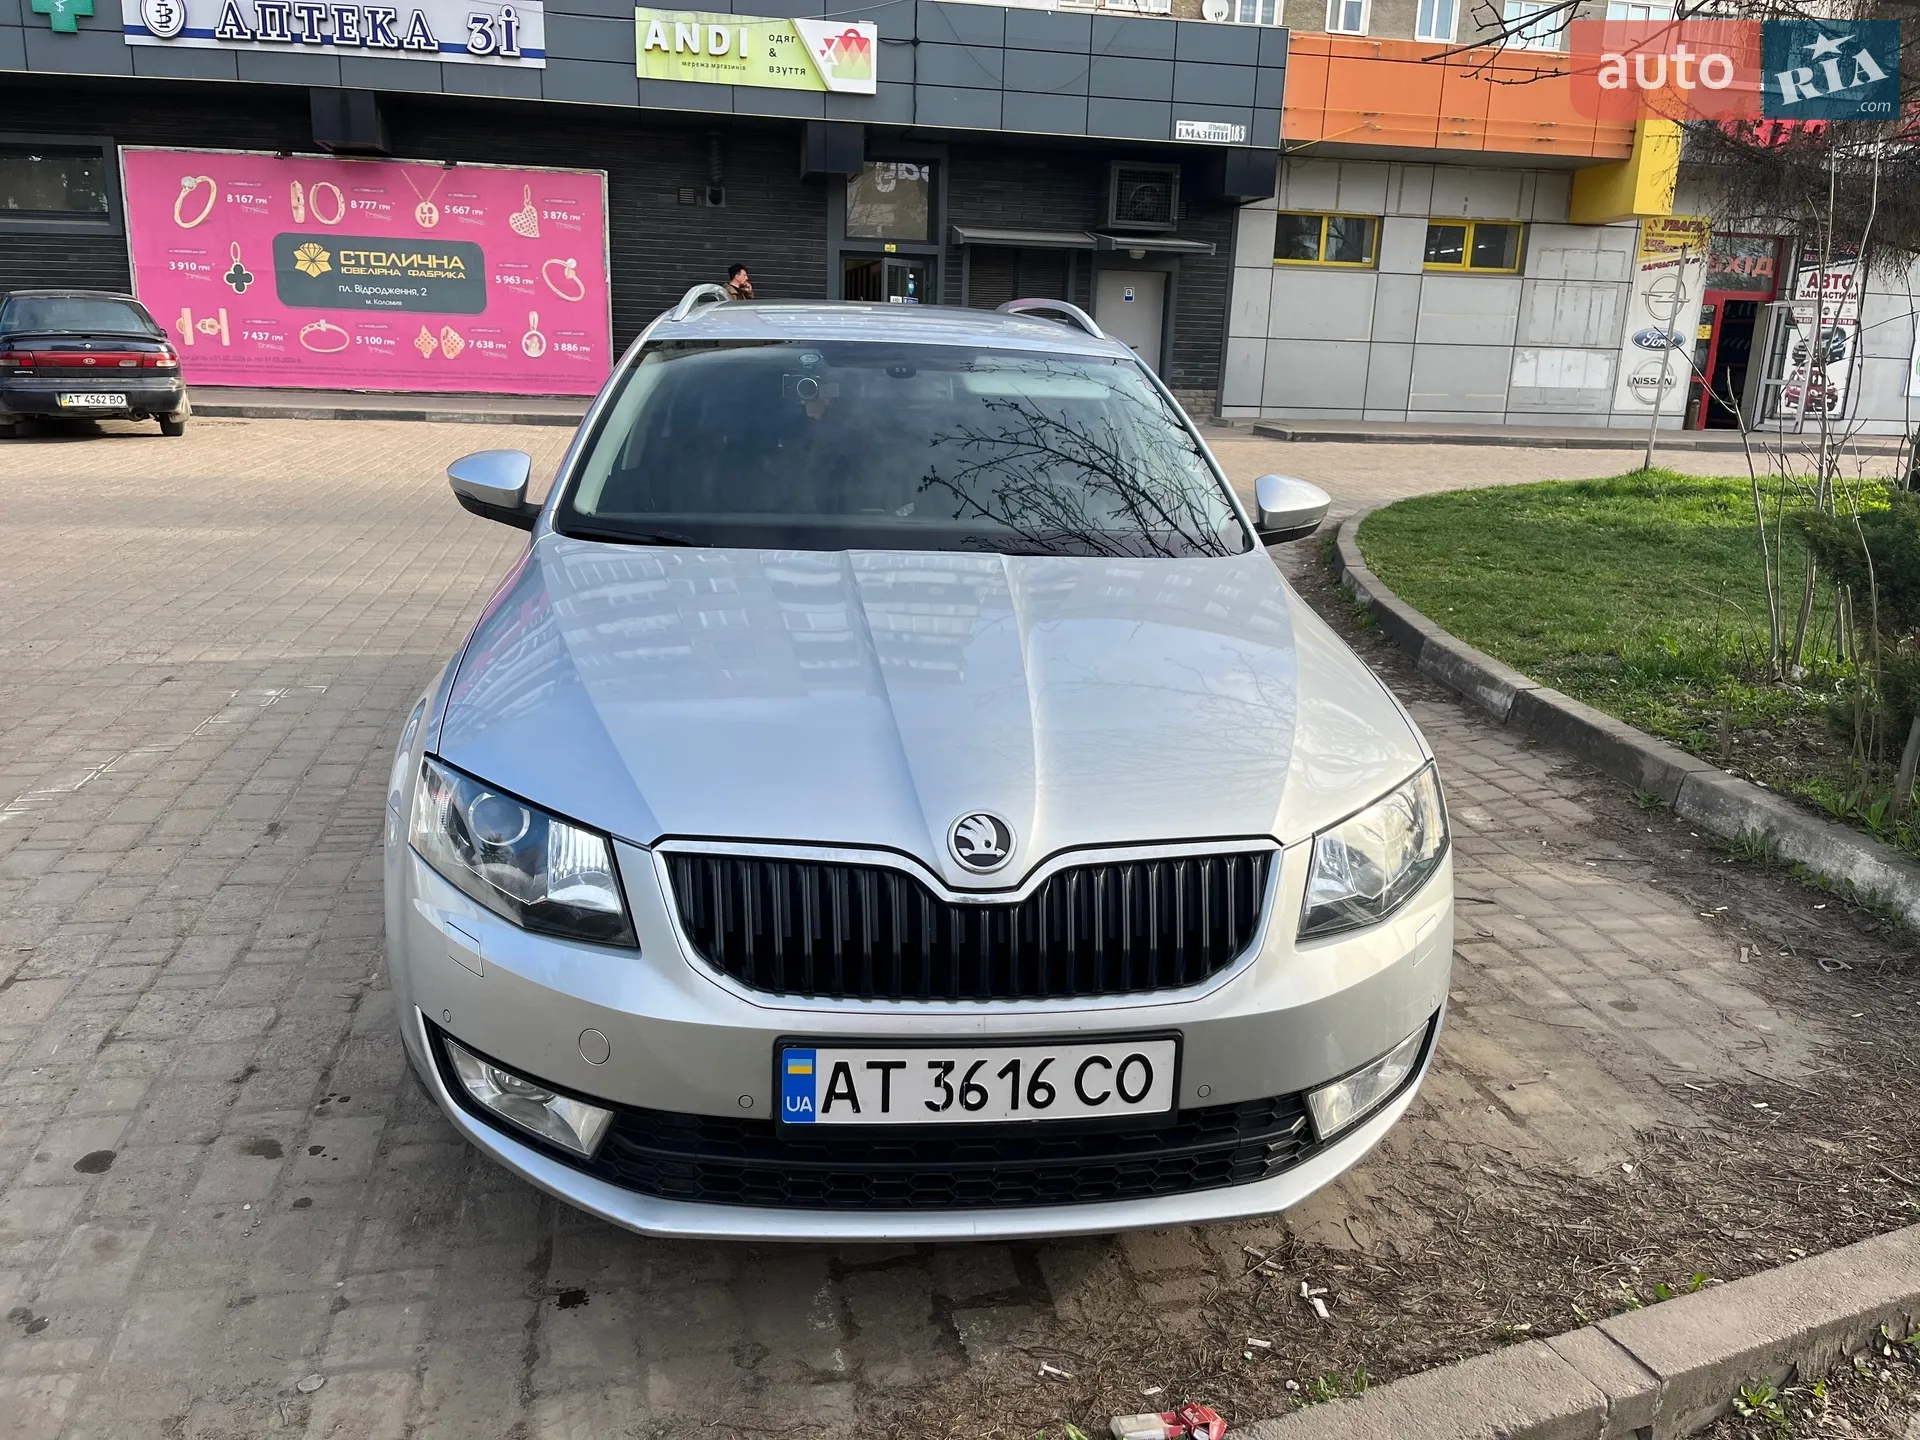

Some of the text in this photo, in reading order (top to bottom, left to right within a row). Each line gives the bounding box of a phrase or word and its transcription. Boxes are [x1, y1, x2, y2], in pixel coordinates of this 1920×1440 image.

[215, 0, 439, 51] АПТЕКА
[644, 20, 748, 59] ANDI
[768, 33, 796, 44] одяг
[769, 47, 777, 57] &
[682, 61, 747, 71] мережа магазинів
[769, 65, 806, 76] взуття
[1231, 125, 1246, 142] 183
[235, 195, 254, 204] 167
[359, 201, 377, 210] 777
[420, 206, 434, 215] LO
[452, 205, 470, 215] 667
[420, 215, 434, 225] VE
[550, 211, 568, 221] 876
[339, 250, 466, 270] СТОЛИЧНА
[177, 262, 197, 271] 910
[341, 267, 466, 279] ЮВЕЛІРНА ФАБРИКА
[503, 276, 521, 285] 963
[1807, 272, 1854, 290] АВТО
[338, 284, 428, 296] пл. Відродження, 2
[1800, 290, 1857, 300] ЗАПАСТИНИ
[374, 298, 403, 306] Коломия
[251, 332, 269, 341] 437
[364, 336, 382, 345] 100
[475, 340, 494, 349] 638
[561, 343, 578, 352] 886
[68, 395, 124, 404] AT 4562 BO
[821, 1053, 1154, 1114] AT 3616 CO
[786, 1096, 813, 1113] UA
